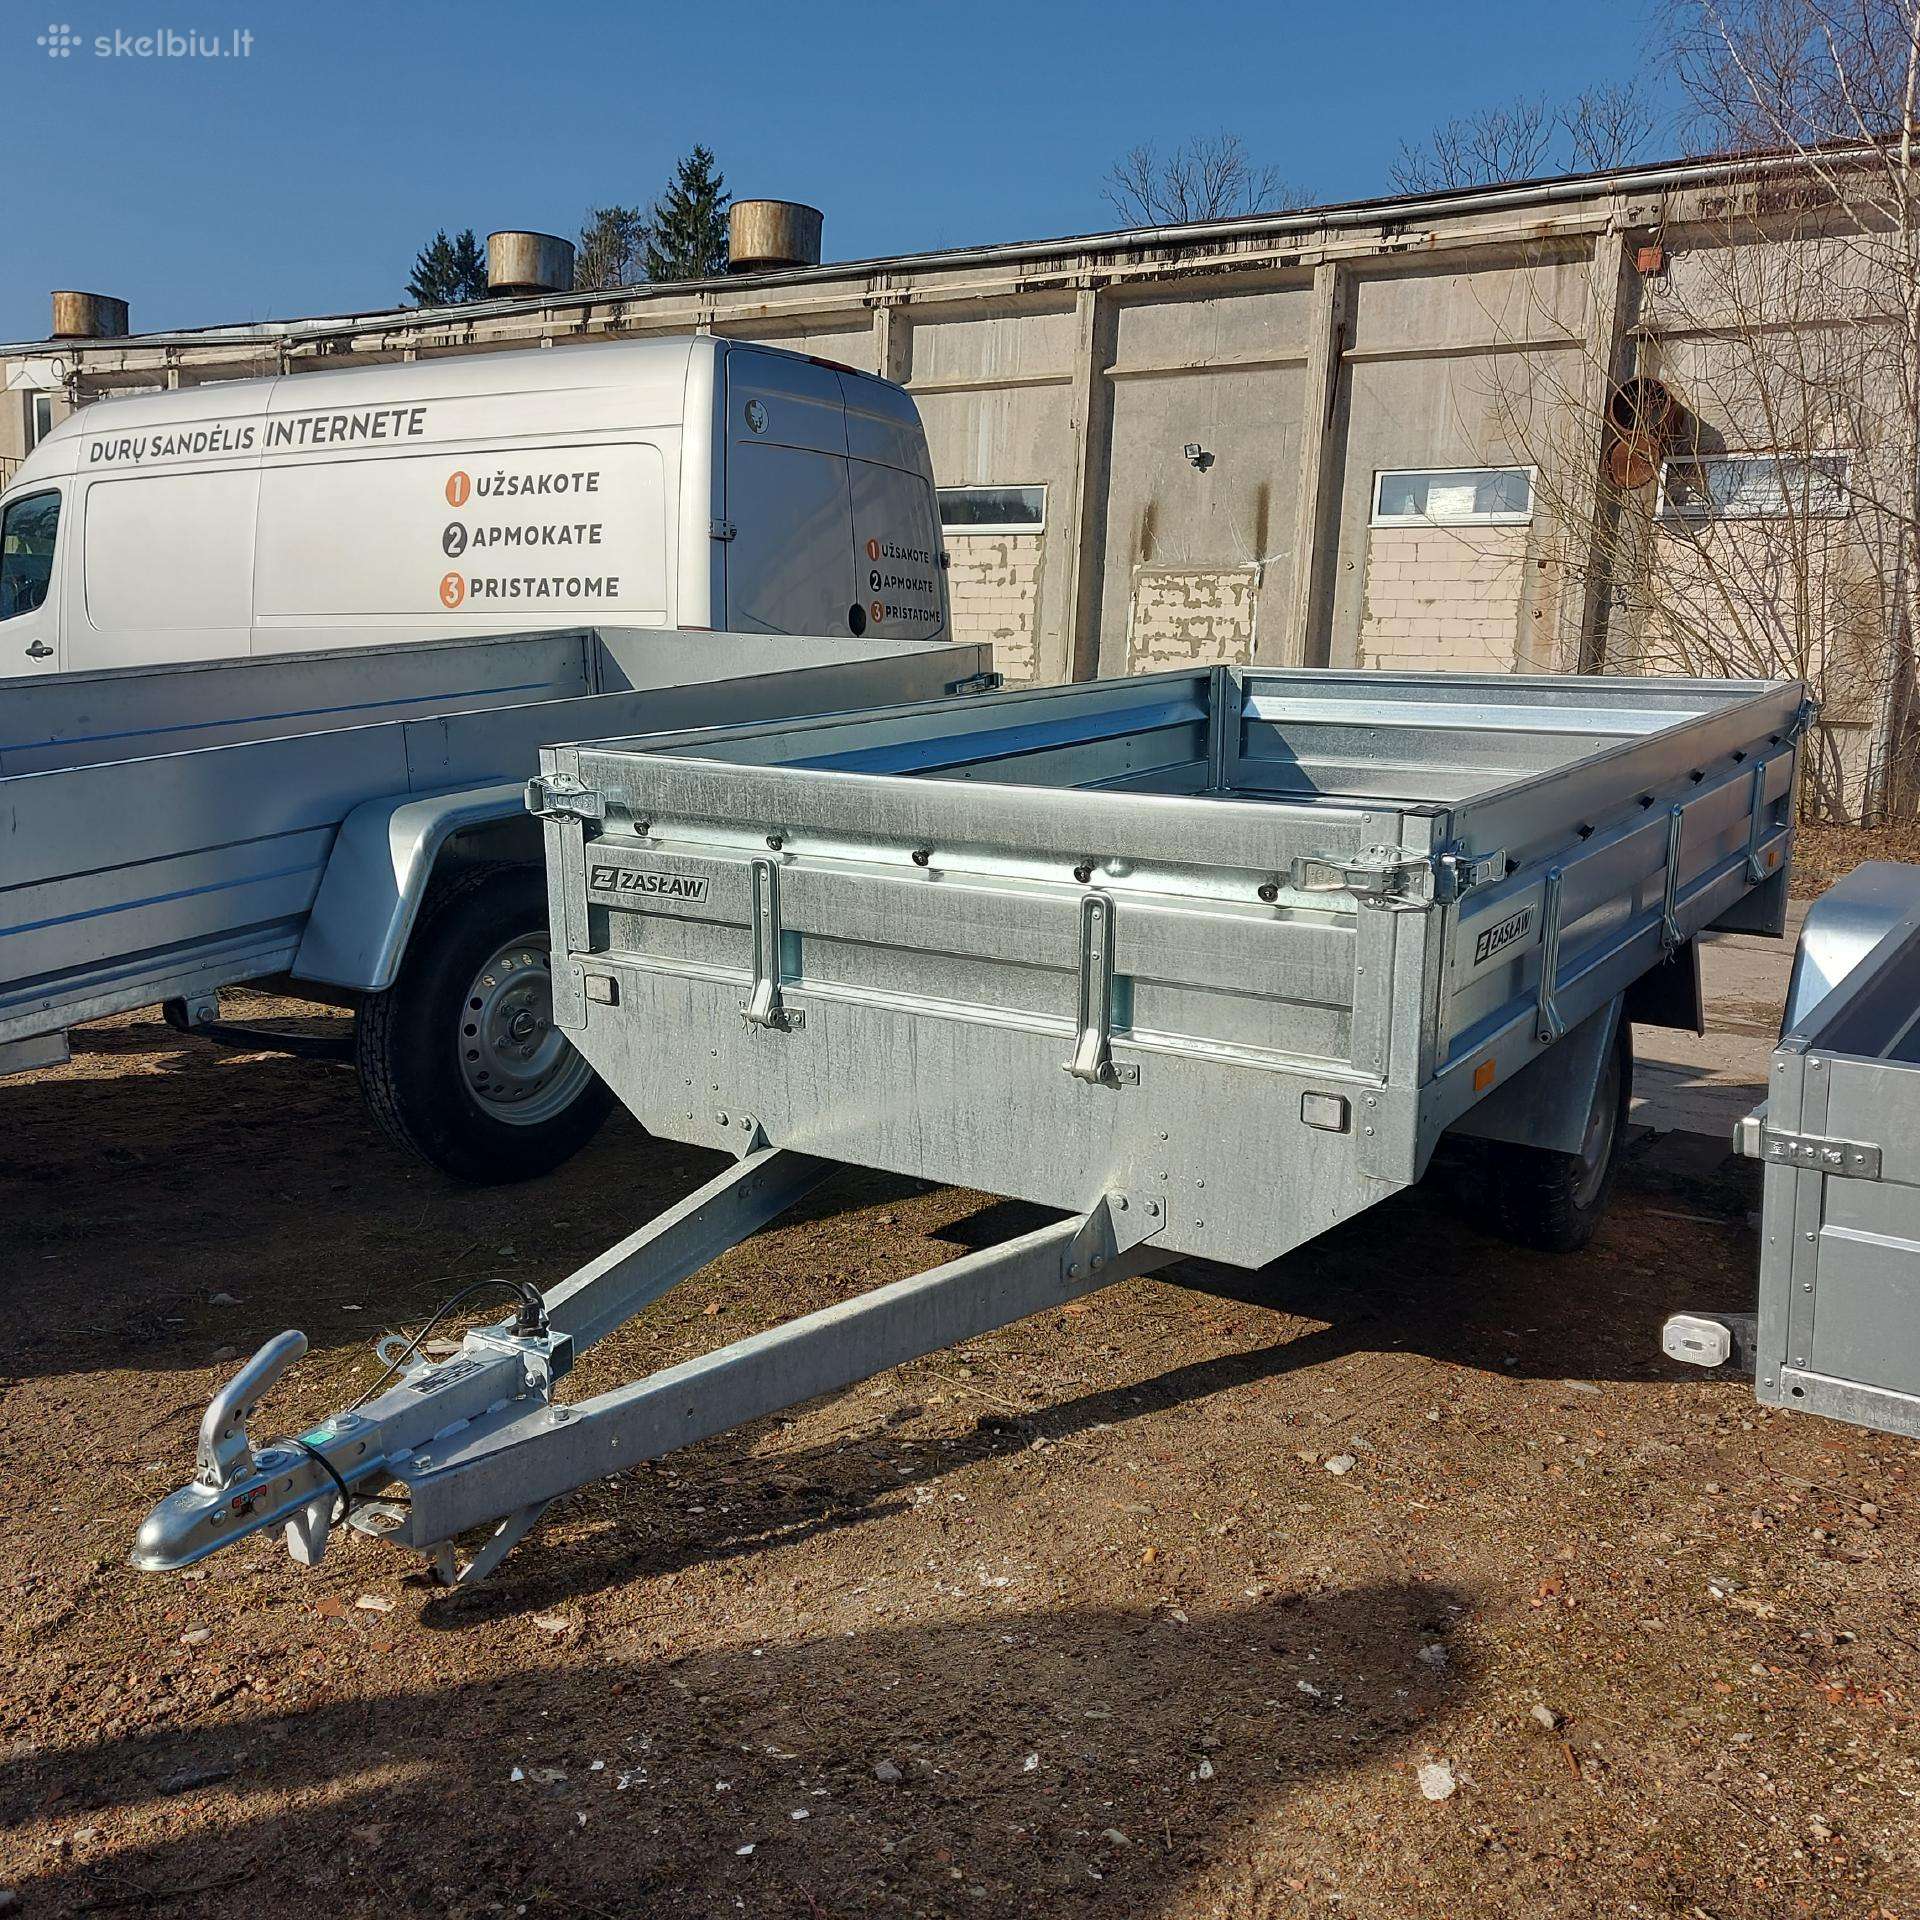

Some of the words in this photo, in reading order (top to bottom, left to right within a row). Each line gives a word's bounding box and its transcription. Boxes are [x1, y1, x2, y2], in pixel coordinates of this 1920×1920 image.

[90, 437, 147, 464] DURŲ
[151, 424, 256, 458] SANDĖLIS
[266, 407, 427, 447] INTERNETE
[476, 470, 600, 497] UŽSAKOTE
[472, 523, 603, 547] APMOKATE
[881, 542, 929, 564] UŽSAKOTE
[470, 577, 620, 598] PRISTATOME
[883, 575, 933, 593] APMOKATE
[885, 605, 941, 623] PRISTATOME
[621, 872, 704, 898] ZASŁAW
[1491, 909, 1531, 951] ZASŁAW
